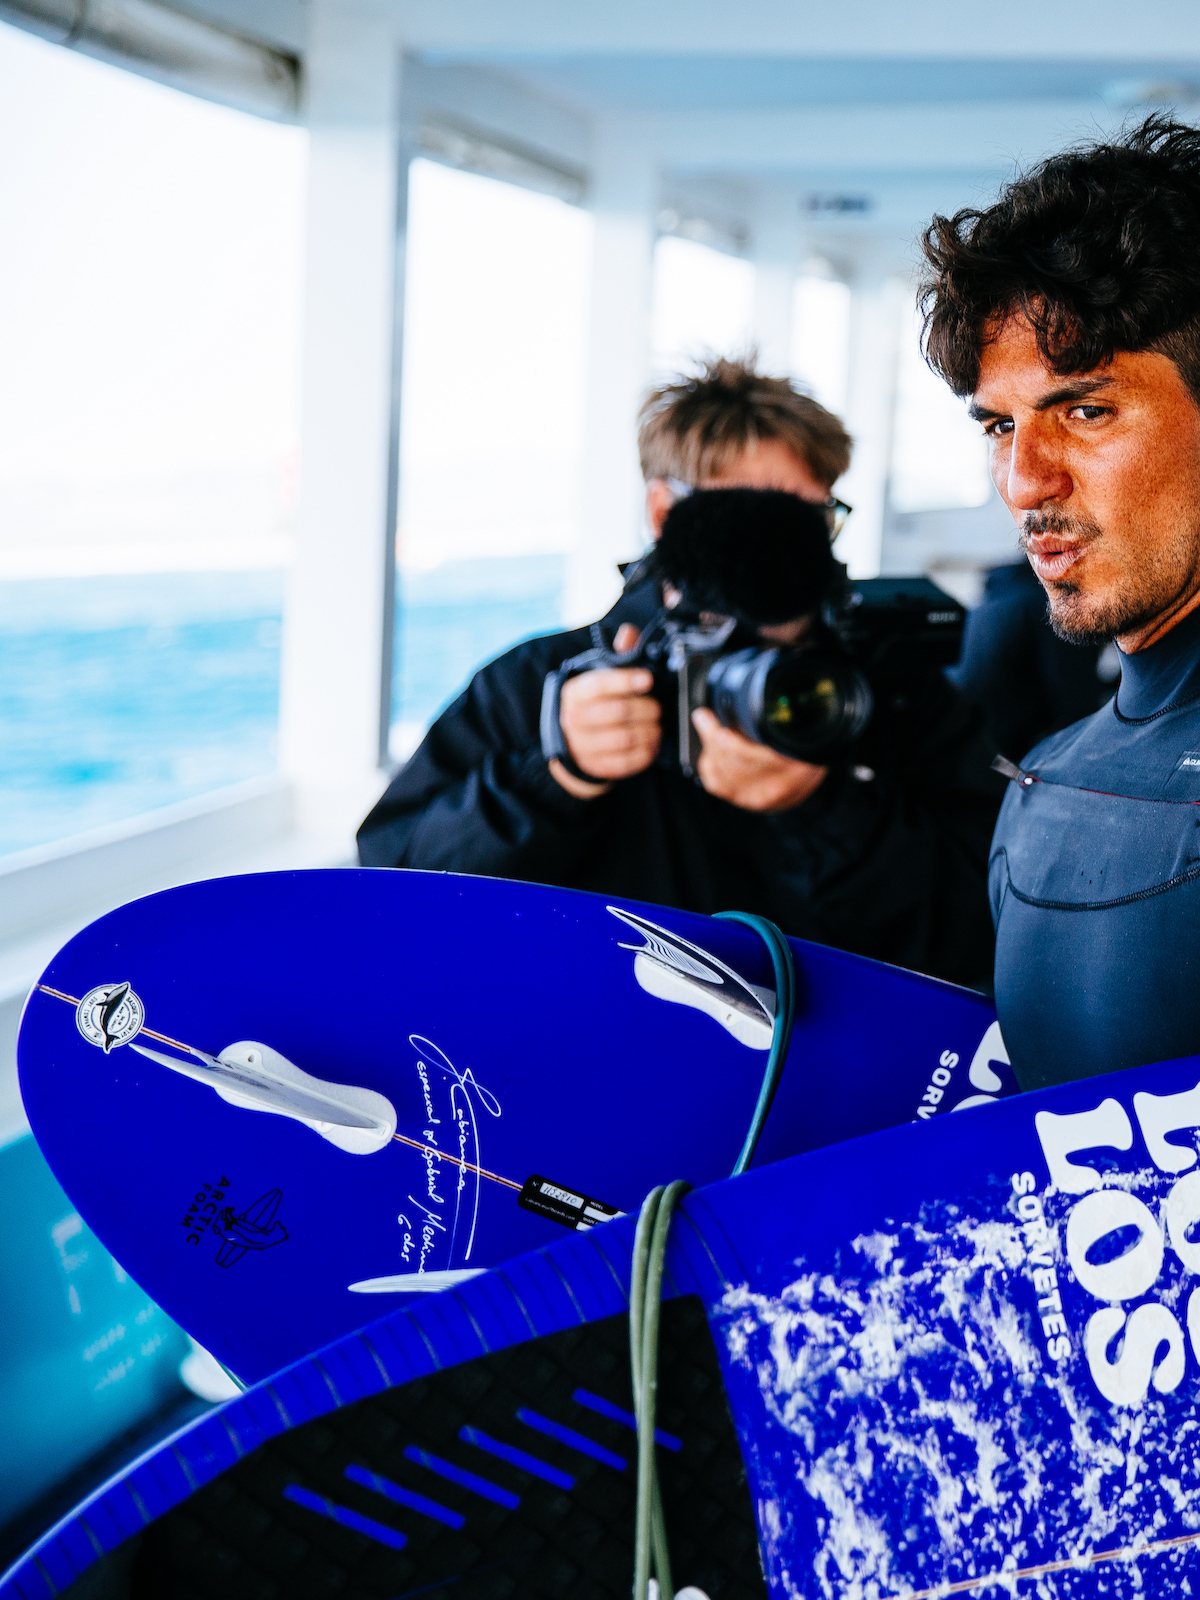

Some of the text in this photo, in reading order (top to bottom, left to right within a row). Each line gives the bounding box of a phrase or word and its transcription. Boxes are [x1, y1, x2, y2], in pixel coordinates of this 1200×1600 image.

[911, 1049, 960, 1124] SORV
[181, 1183, 212, 1228] FOAM
[186, 1175, 231, 1247] ARCTIC
[1011, 1170, 1070, 1362] SORVETES
[1035, 1098, 1186, 1406] LOS
